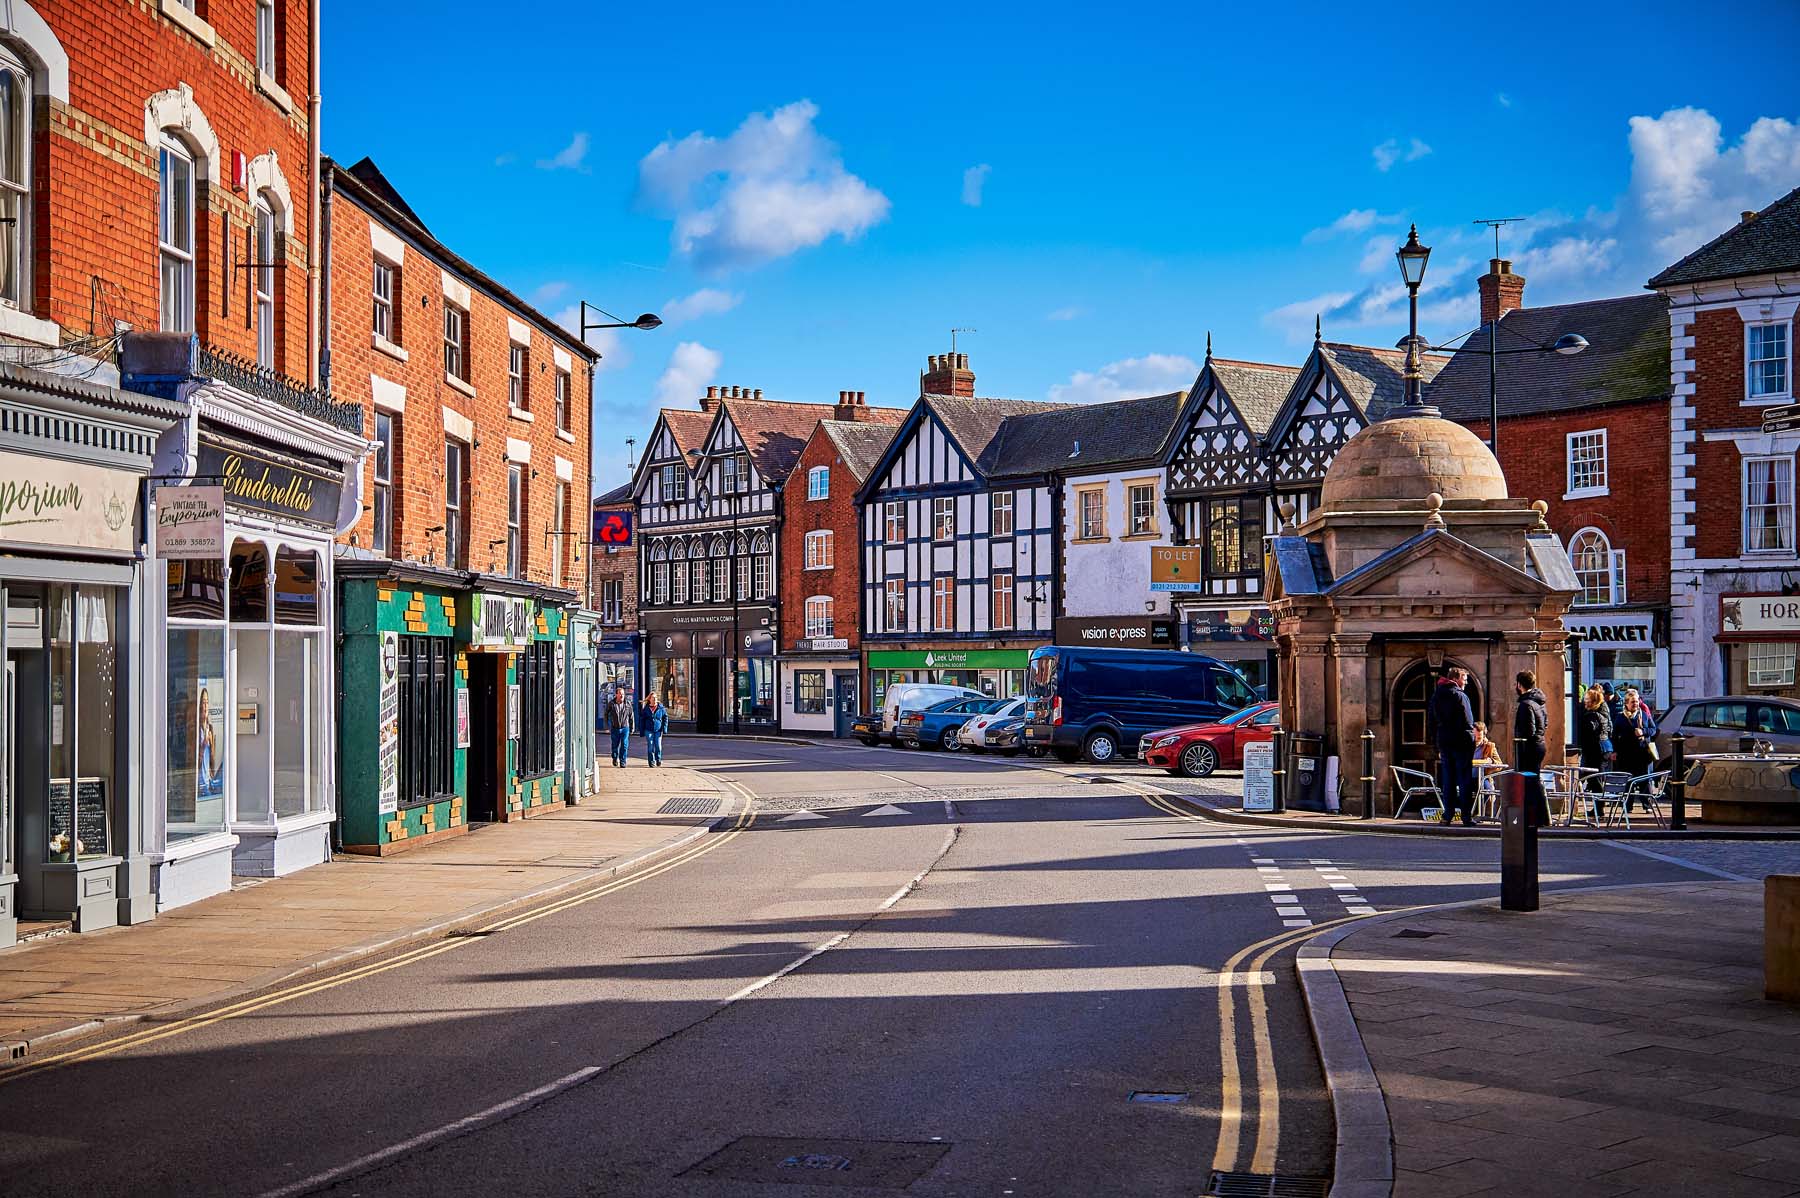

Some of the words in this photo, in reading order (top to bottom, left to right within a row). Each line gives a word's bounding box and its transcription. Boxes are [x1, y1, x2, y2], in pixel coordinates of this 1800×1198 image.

[222, 455, 315, 512] Cinderella's
[172, 501, 196, 510] VINTAGE
[198, 501, 208, 510] TEA
[159, 506, 222, 528] Emporium
[1158, 551, 1171, 560] TO
[1176, 551, 1194, 560] LET
[1760, 603, 1800, 619] HOR
[1081, 626, 1107, 639] vision
[1109, 627, 1147, 641] express
[1571, 625, 1648, 641] MARKET
[828, 640, 847, 648] STUDIO
[934, 652, 947, 662] Leek
[948, 652, 967, 662] United
